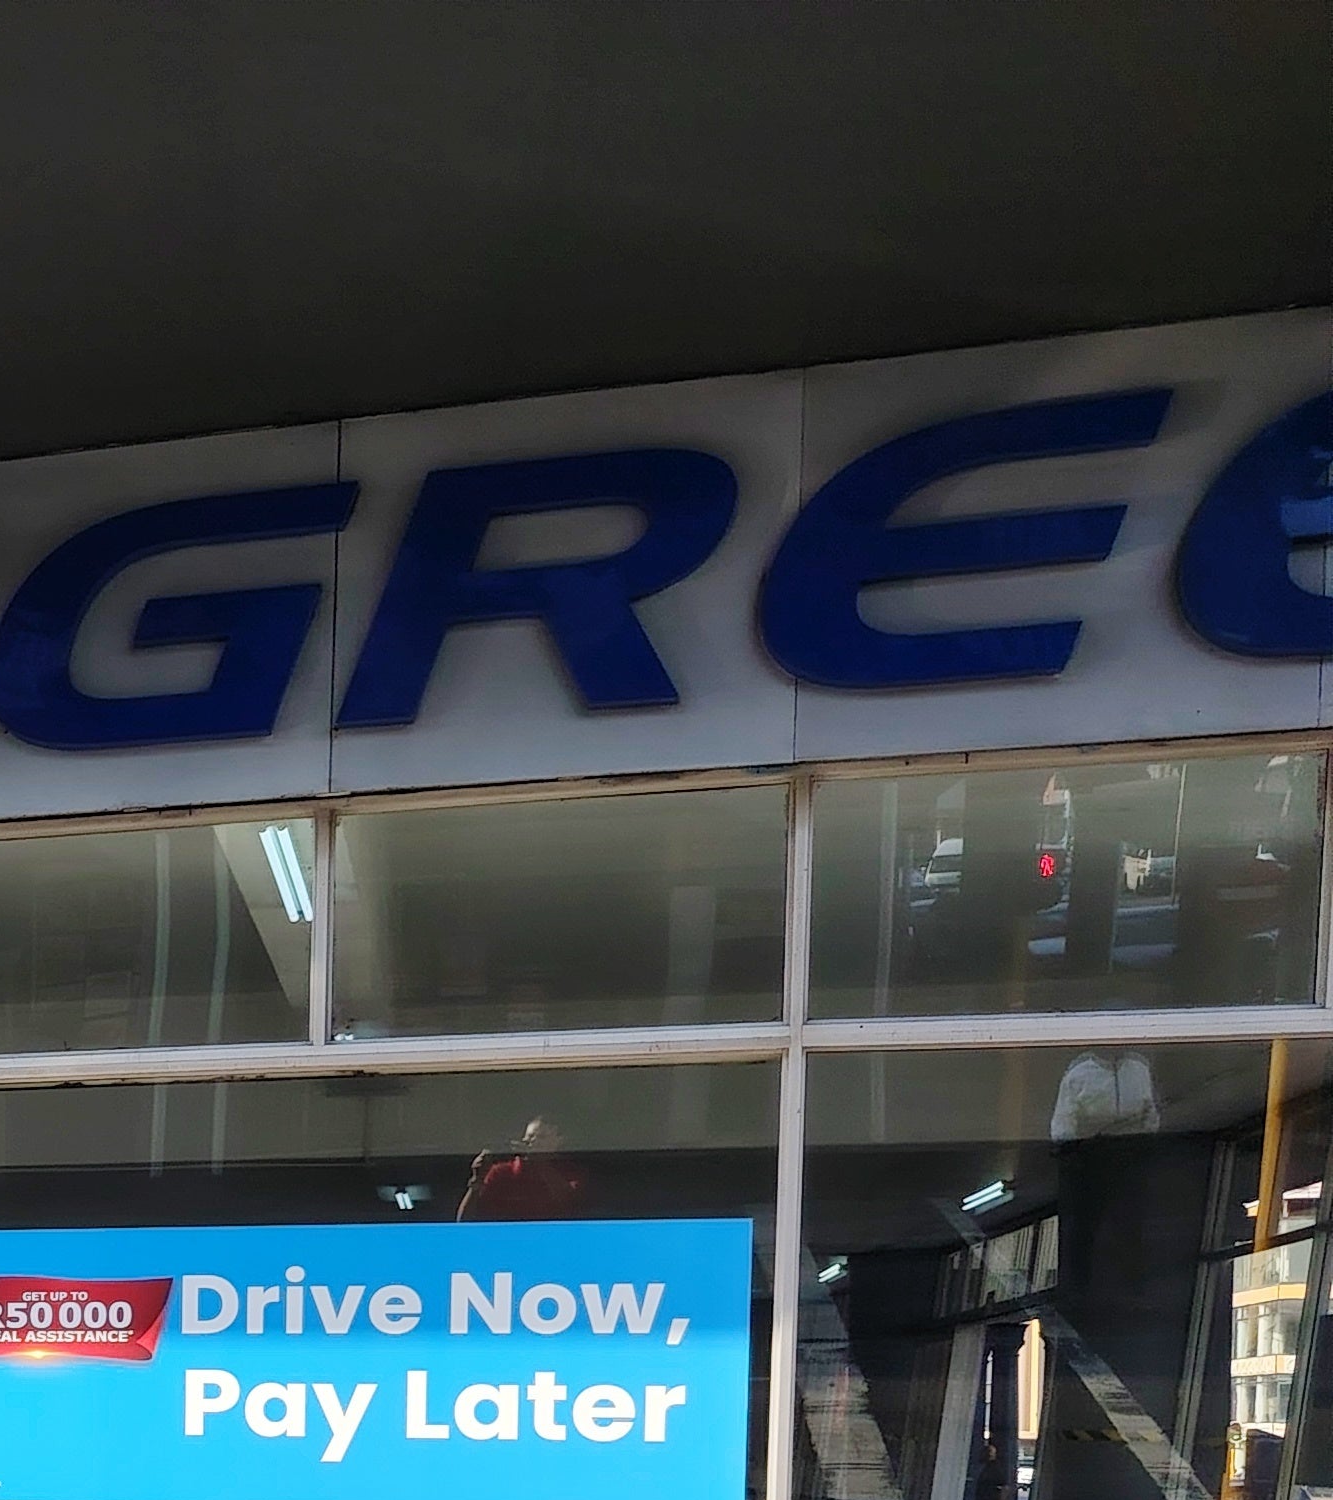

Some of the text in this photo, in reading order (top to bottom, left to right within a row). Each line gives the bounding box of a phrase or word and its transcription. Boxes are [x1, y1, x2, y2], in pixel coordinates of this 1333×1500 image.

[22, 1291, 88, 1302] GET UP TO
[59, 1301, 132, 1329] 000
[181, 1266, 691, 1345] Drive Now,
[184, 1369, 686, 1462] Pay Later
